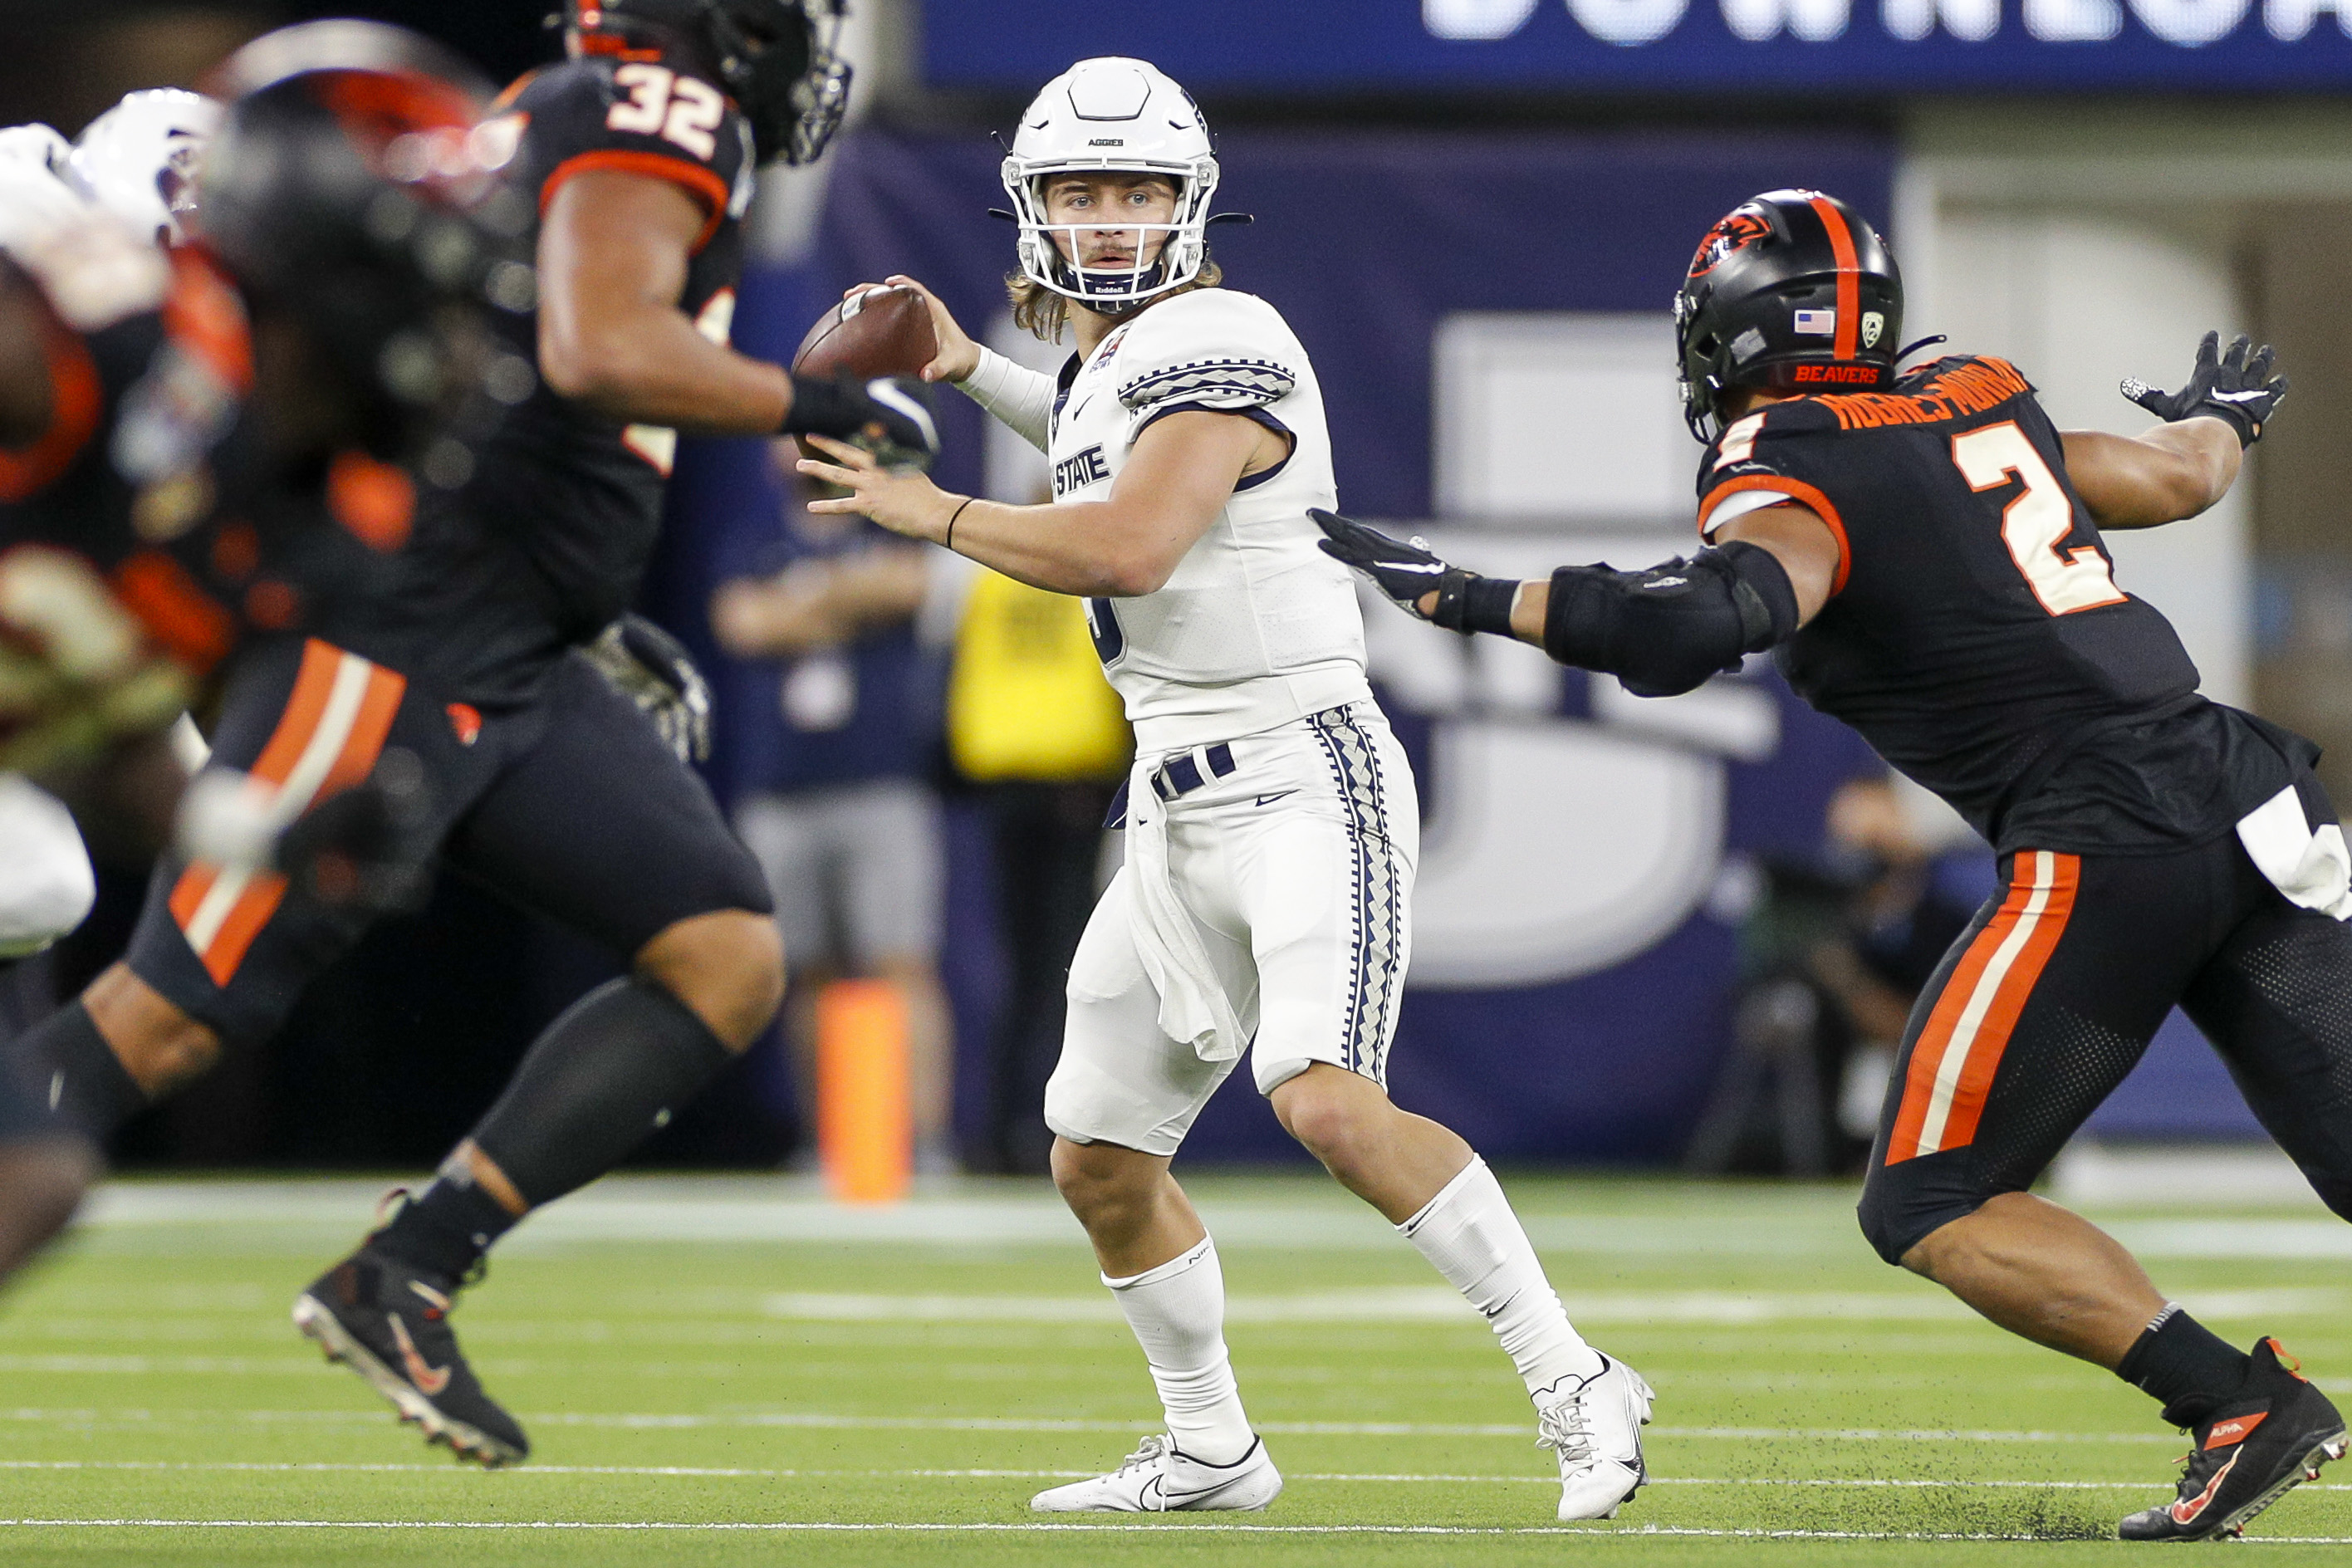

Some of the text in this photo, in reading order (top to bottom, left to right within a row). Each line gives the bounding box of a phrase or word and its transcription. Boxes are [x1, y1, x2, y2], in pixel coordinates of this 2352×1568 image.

[605, 63, 724, 161] 32
[1794, 365, 1879, 384] BEAVERS
[1056, 443, 1114, 497] STATE
[1952, 419, 2129, 617] 2
[2210, 1423, 2244, 1438] ALPHA
